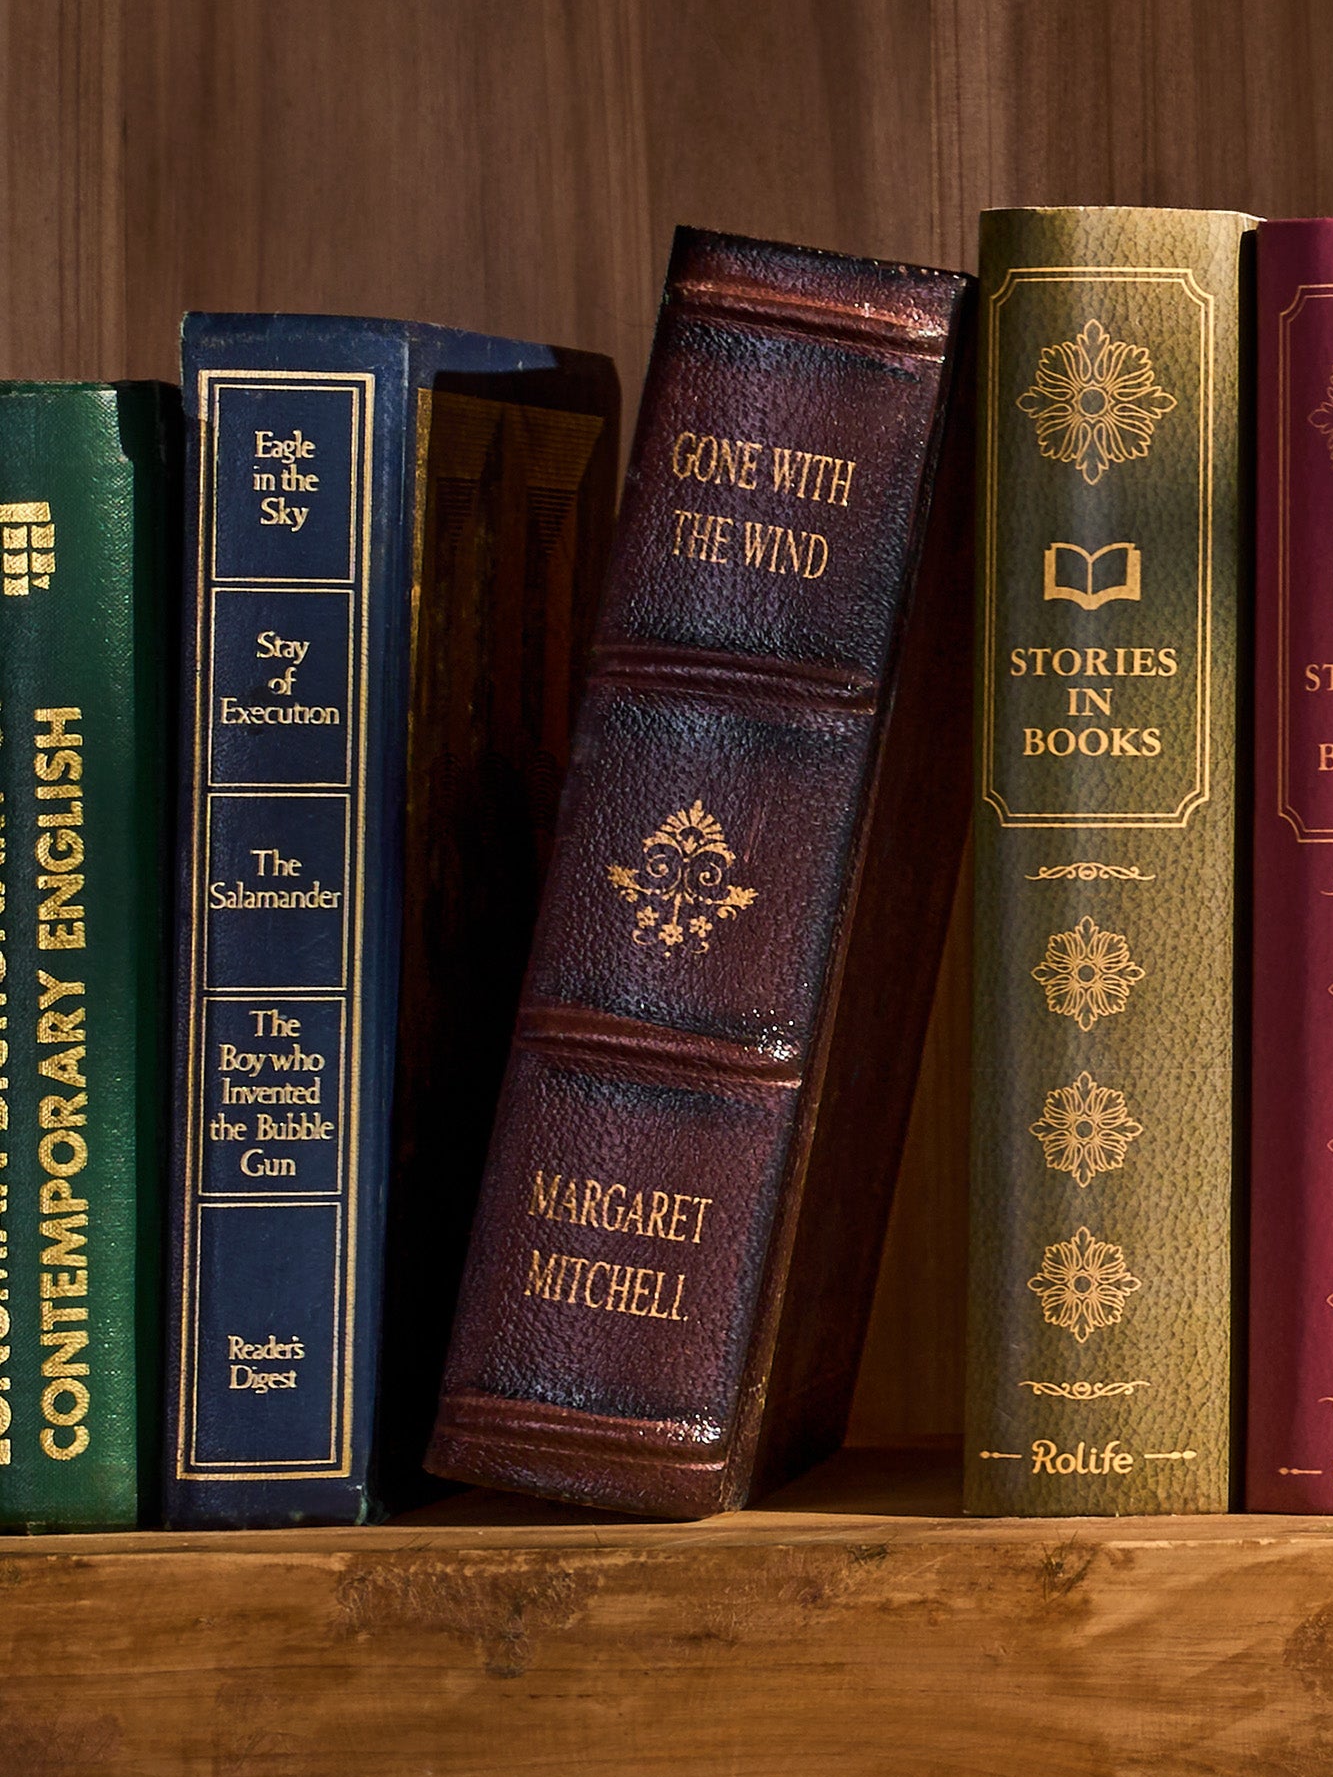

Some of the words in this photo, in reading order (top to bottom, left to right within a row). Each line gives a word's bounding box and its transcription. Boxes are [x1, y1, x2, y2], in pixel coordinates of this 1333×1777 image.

[253, 430, 316, 461] Eagle
[252, 465, 277, 492] in
[281, 465, 320, 492] the
[671, 430, 764, 491] GONE
[771, 446, 857, 509] WITH
[259, 498, 310, 532] Sky
[672, 509, 736, 566] THE
[742, 523, 830, 582] WIND
[256, 630, 310, 664] Stay
[1010, 646, 1180, 680] STORIES
[269, 668, 297, 696] of
[219, 696, 341, 727] Execution
[1066, 687, 1114, 717] IN
[1021, 727, 1163, 758] BOOKS
[33, 706, 86, 950] ENGLISH
[250, 848, 303, 878] The
[209, 882, 342, 911] Salamander
[249, 1008, 302, 1039] The
[218, 1042, 266, 1080] Boy
[265, 1044, 325, 1074] who
[220, 1077, 322, 1107] Invented
[208, 1115, 249, 1142] the
[255, 1113, 335, 1142] Bubble
[239, 1149, 297, 1179] Gun
[37, 969, 90, 1462] CONTEMPORARY
[527, 1169, 714, 1246] MARGARET
[522, 1249, 690, 1324] MITCHELL
[226, 1334, 306, 1361] Reader's
[228, 1365, 298, 1396] Digest
[1030, 1439, 1135, 1477] Rolife
